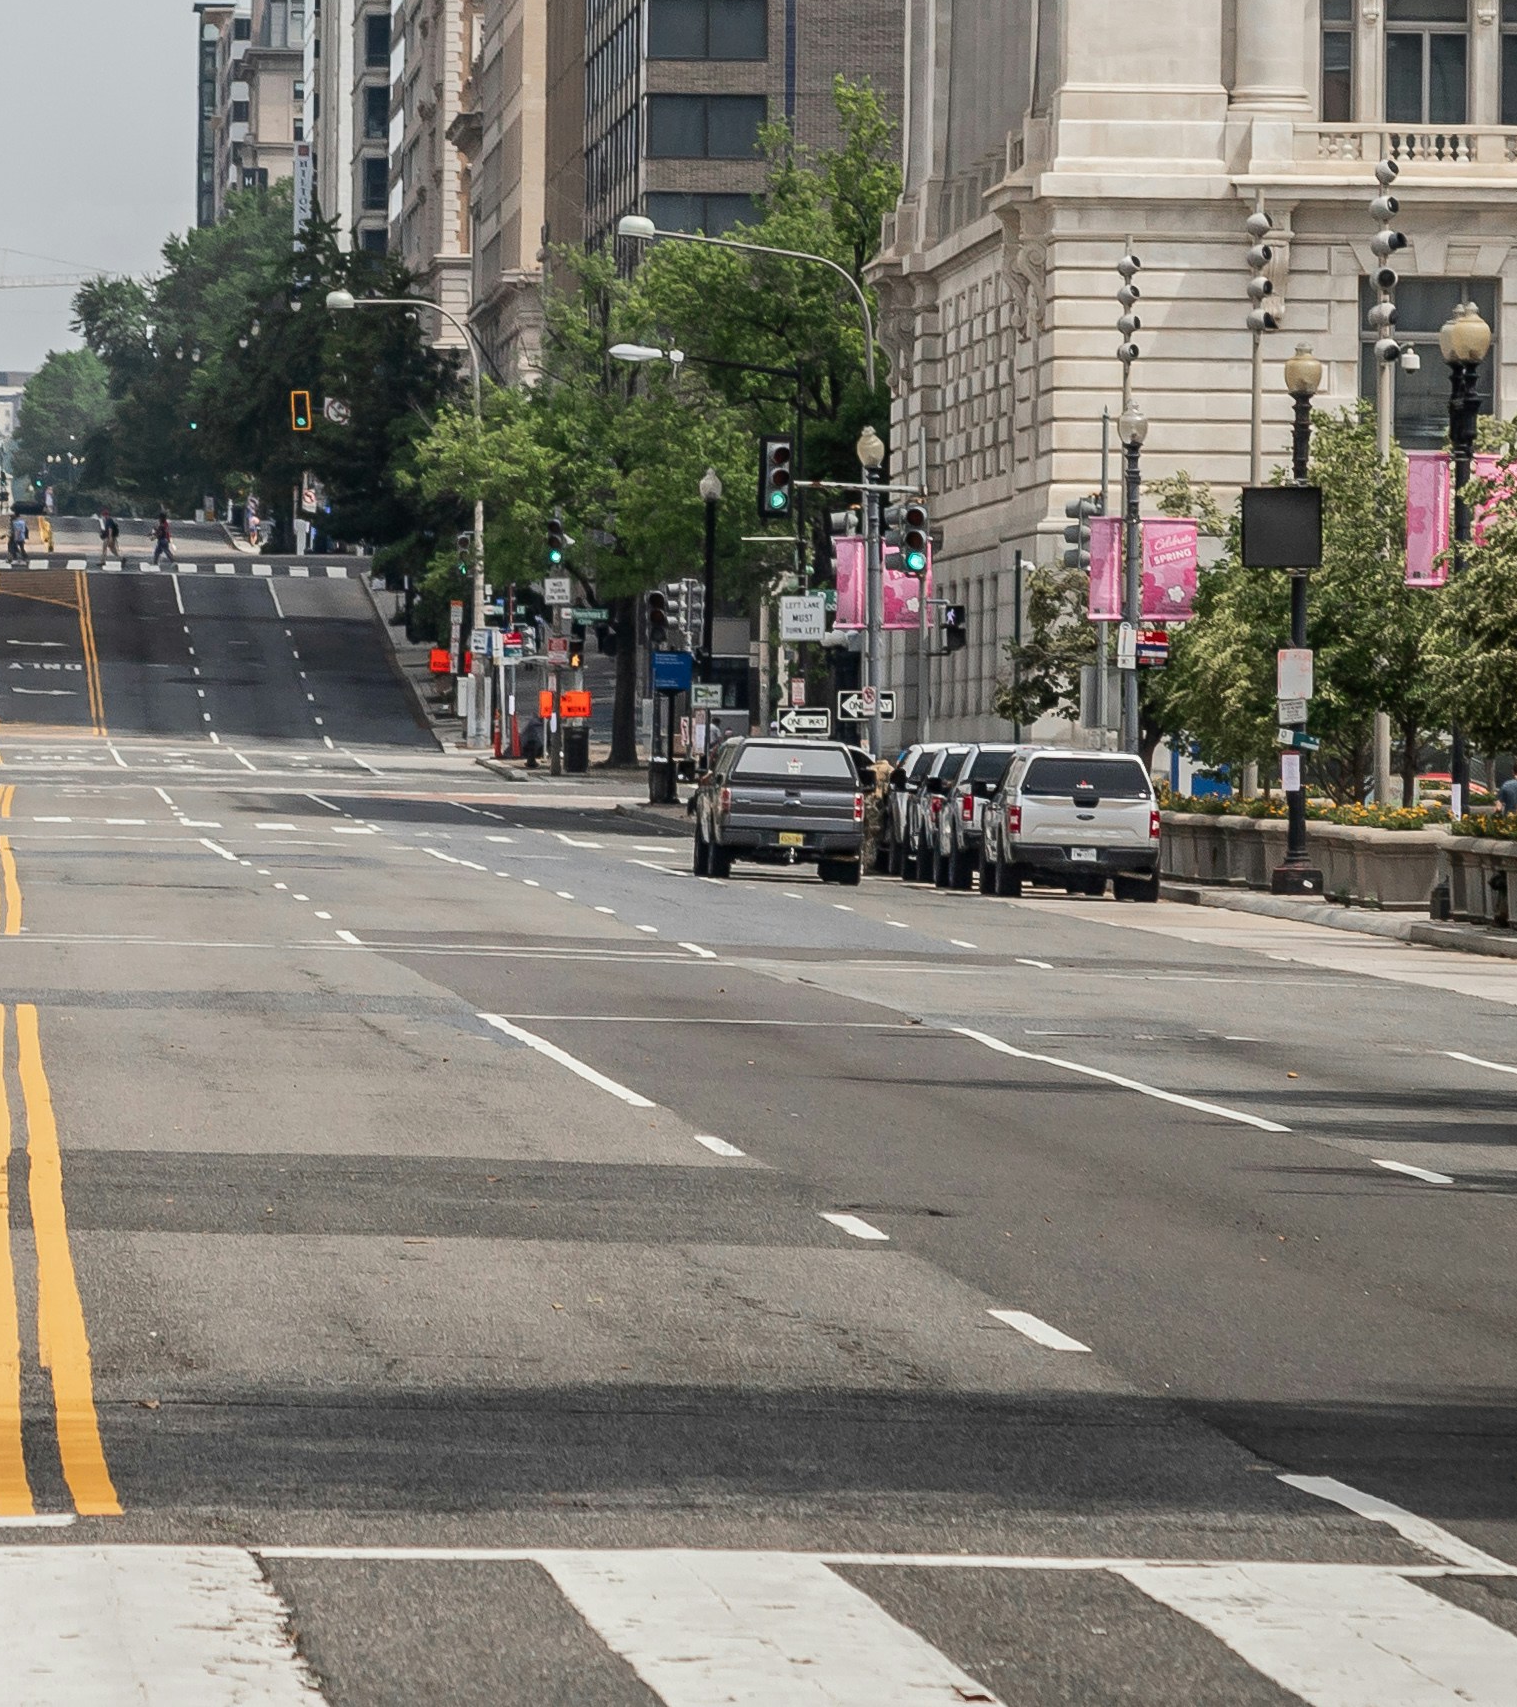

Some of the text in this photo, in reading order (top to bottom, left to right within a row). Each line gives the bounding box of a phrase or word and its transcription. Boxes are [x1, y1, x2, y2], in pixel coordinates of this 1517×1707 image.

[299, 160, 308, 213] HILTON
[1154, 534, 1192, 551] Celebrate
[1153, 548, 1192, 565] SPRING
[785, 602, 802, 610] LEFT
[803, 601, 820, 610] LANE
[792, 614, 814, 622] MUST
[785, 627, 821, 635] TURN LEFT
[849, 701, 864, 710] ON
[787, 717, 825, 726] ONE WAY
